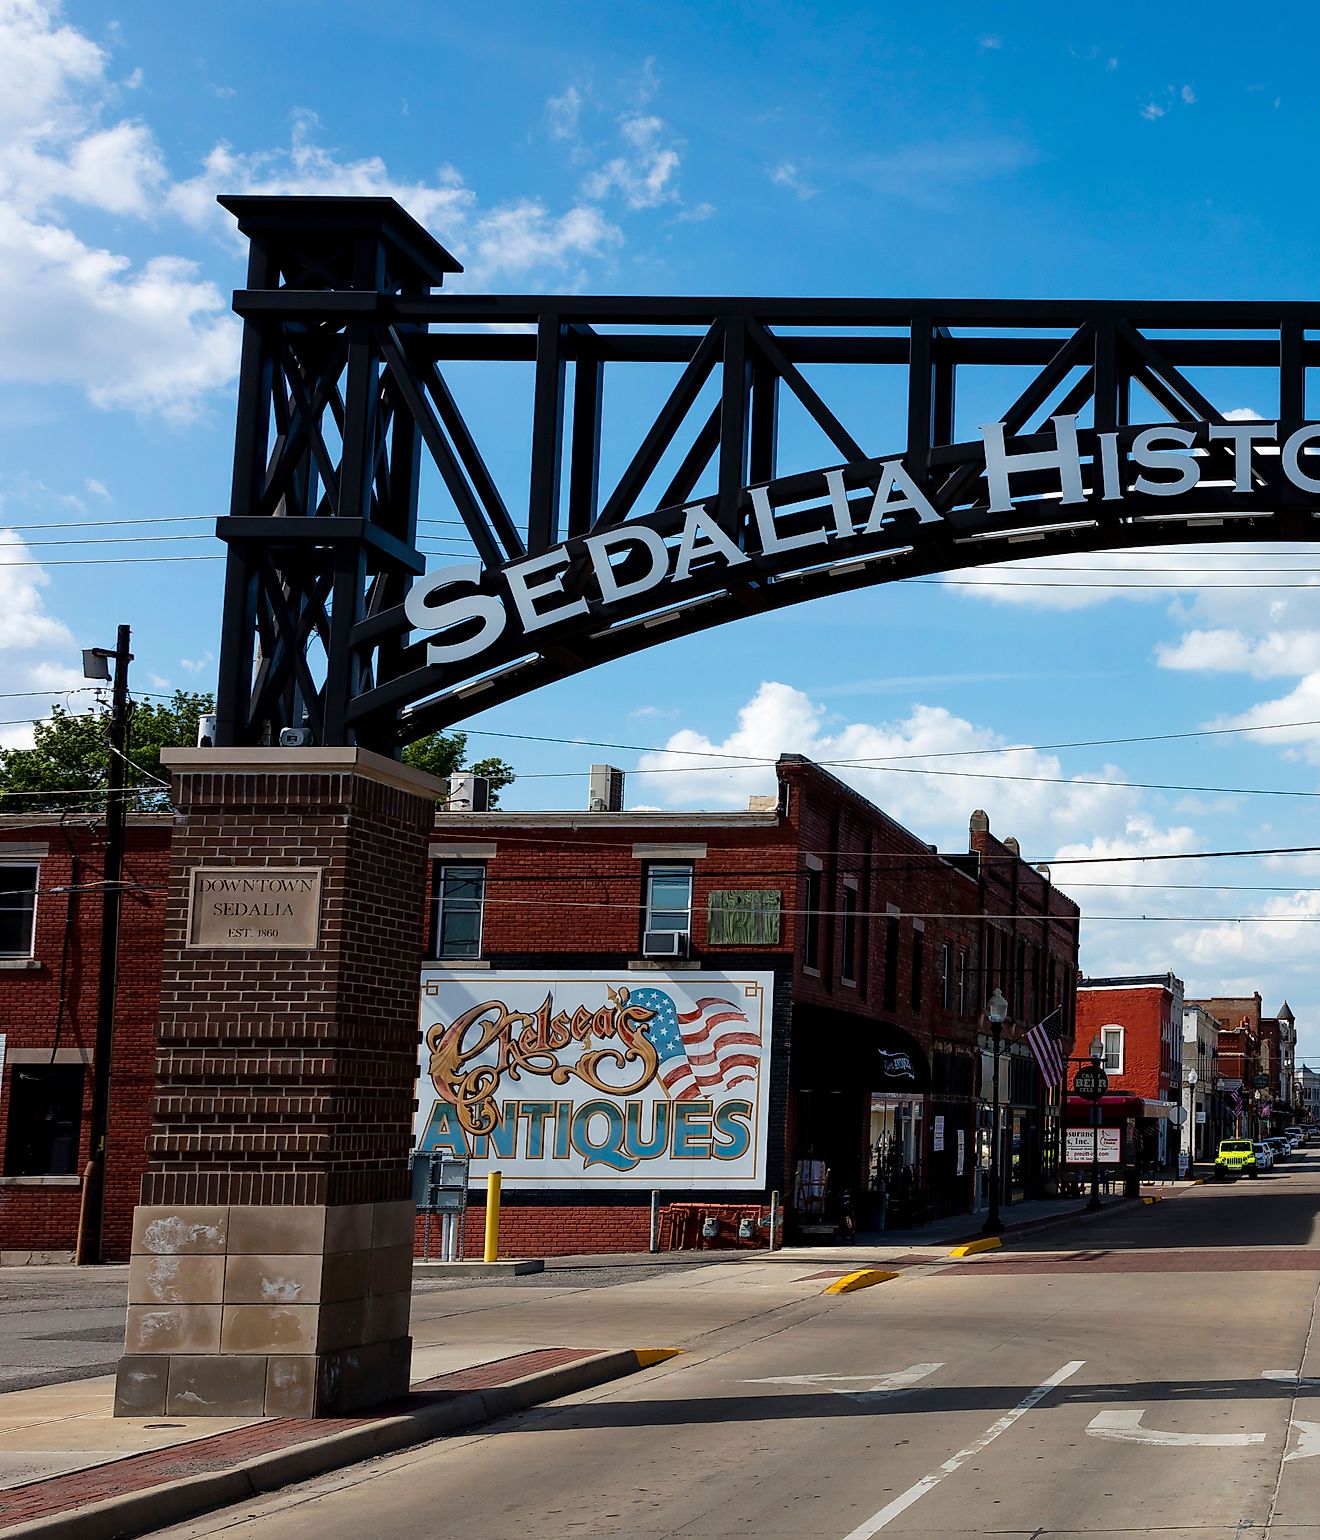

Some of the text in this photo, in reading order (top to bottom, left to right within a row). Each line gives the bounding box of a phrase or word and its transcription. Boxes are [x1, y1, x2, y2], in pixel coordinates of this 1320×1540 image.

[404, 460, 943, 666] SEDALIA
[200, 879, 314, 893] DOWNTOWN
[213, 902, 294, 916] SEDALIA
[228, 928, 279, 938] EST. 1860
[419, 1099, 753, 1171] ANTIQUES
